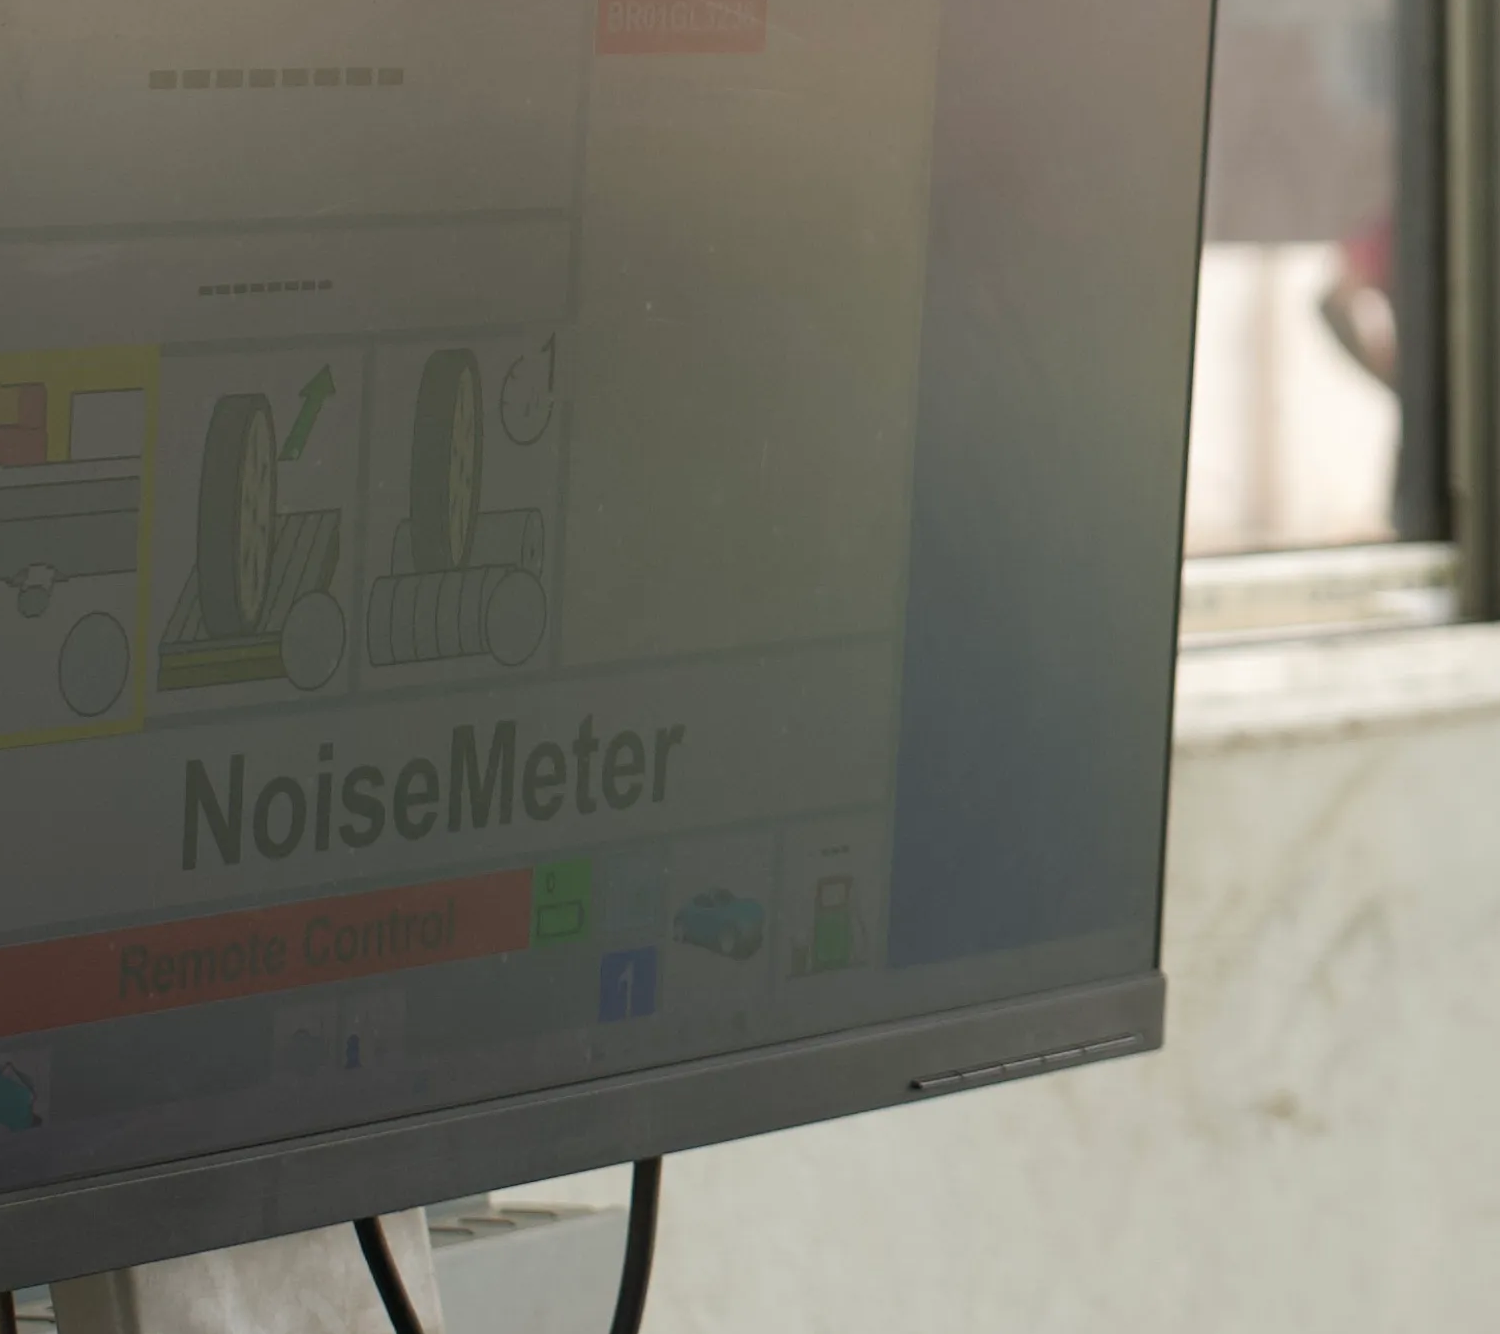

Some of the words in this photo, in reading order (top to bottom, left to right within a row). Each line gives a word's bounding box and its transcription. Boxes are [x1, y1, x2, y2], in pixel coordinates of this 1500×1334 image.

[181, 712, 685, 871] NoiseMeter
[118, 937, 287, 1000] Remote
[302, 900, 457, 969] Control
